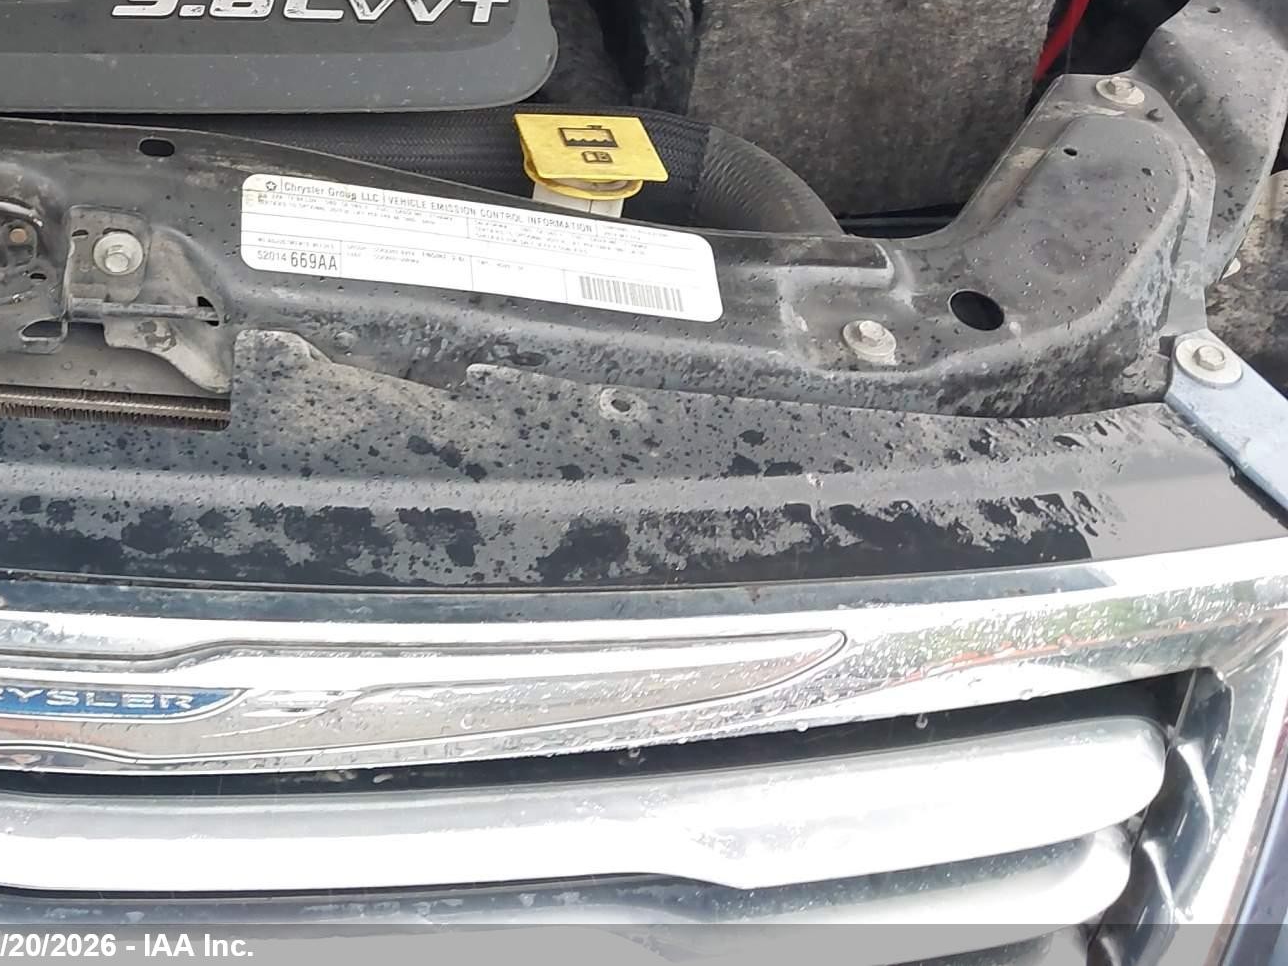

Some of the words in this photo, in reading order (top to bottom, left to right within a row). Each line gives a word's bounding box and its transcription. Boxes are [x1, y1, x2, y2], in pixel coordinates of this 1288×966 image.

[284, 181, 324, 195] Chrysler
[328, 187, 357, 201] Group
[361, 192, 380, 203] LLC
[388, 195, 427, 210] VEHICLE
[431, 202, 476, 217] EMISSION
[480, 208, 523, 223] CONTROL
[527, 217, 593, 233] INFORMATION
